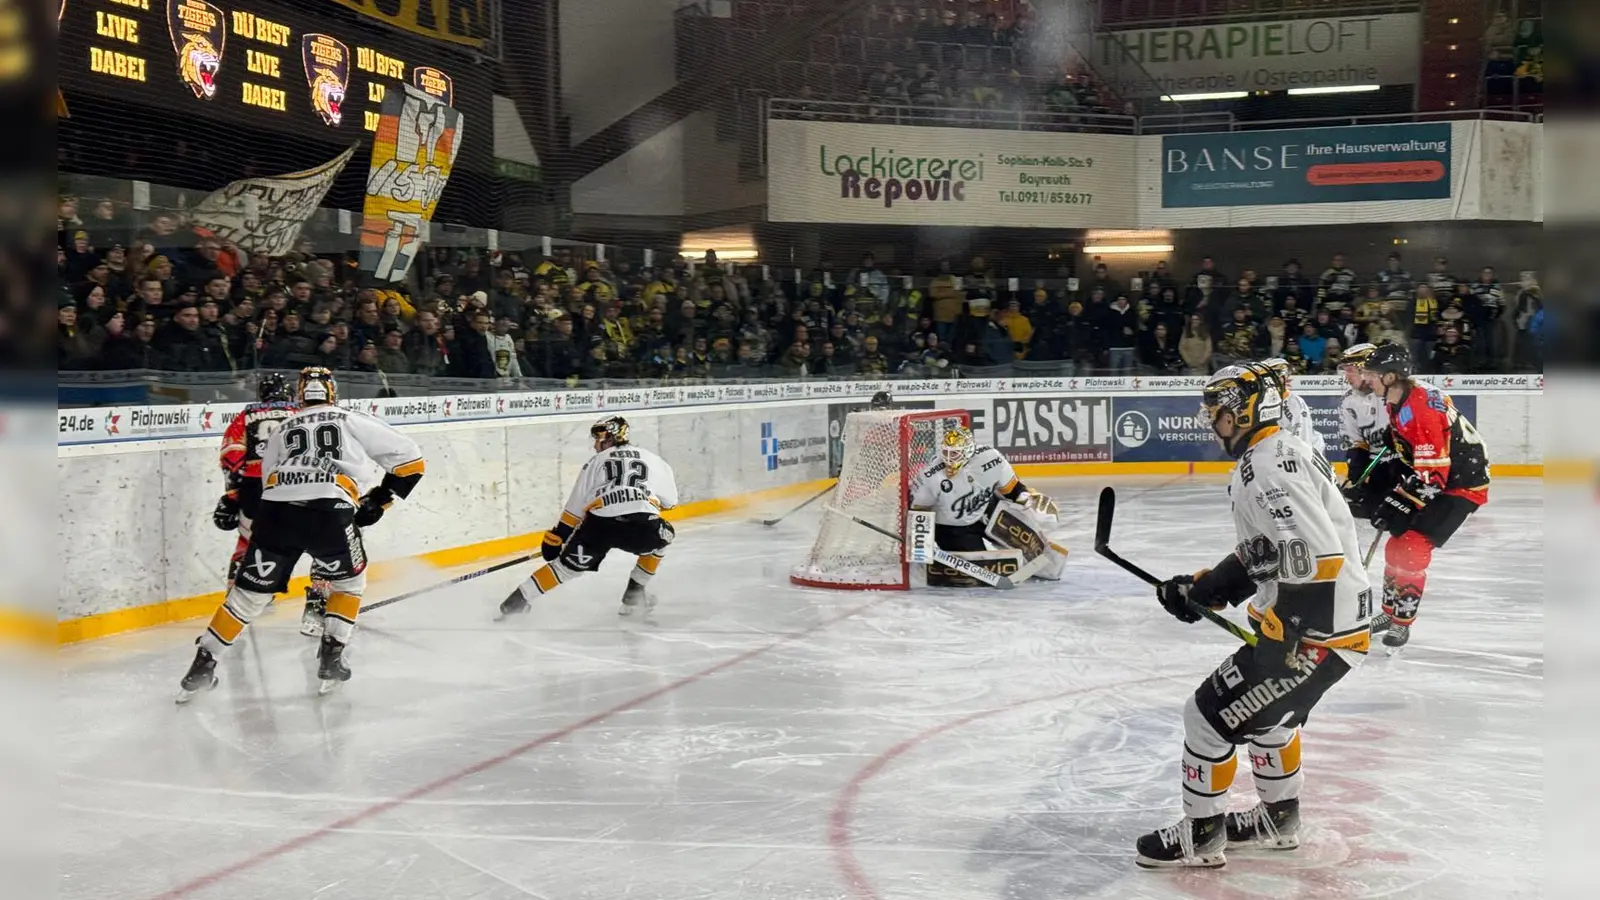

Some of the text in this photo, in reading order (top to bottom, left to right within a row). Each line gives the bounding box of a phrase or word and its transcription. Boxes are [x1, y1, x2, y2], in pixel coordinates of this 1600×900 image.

[96, 11, 139, 44] LIVE
[178, 4, 216, 27] TIGERS
[232, 11, 254, 37] DU
[255, 18, 290, 47] BIST
[310, 41, 342, 63] TIGERS
[1096, 18, 1380, 65] THERAPIELOFT
[90, 47, 146, 82] DABEI
[246, 49, 280, 78] LIVE
[357, 47, 405, 80] DU BIST
[1254, 64, 1378, 87] Osteopathie
[242, 82, 286, 112] DABEI
[368, 82, 385, 103] LI
[1167, 144, 1299, 174] BANSE
[1306, 139, 1448, 156] Ihre Hausverwaltung
[819, 144, 984, 182] Lackiererei
[1019, 172, 1071, 187] Bayreuth
[384, 401, 437, 418] www.pio-24.de
[456, 396, 491, 411] Piotrowski
[956, 380, 992, 389] Piotrowski
[1011, 380, 1063, 389] www.pio-24.de
[1084, 378, 1126, 387] Piotrowski
[1148, 378, 1206, 388] www.pio-24.de
[1462, 377, 1527, 387] www.pio-24.de
[131, 408, 190, 427] Piotrowski
[994, 397, 1112, 449] PASST!
[283, 422, 343, 461] 28
[602, 458, 649, 488] 42
[1268, 505, 1294, 519] SAS
[1277, 538, 1312, 579] 18
